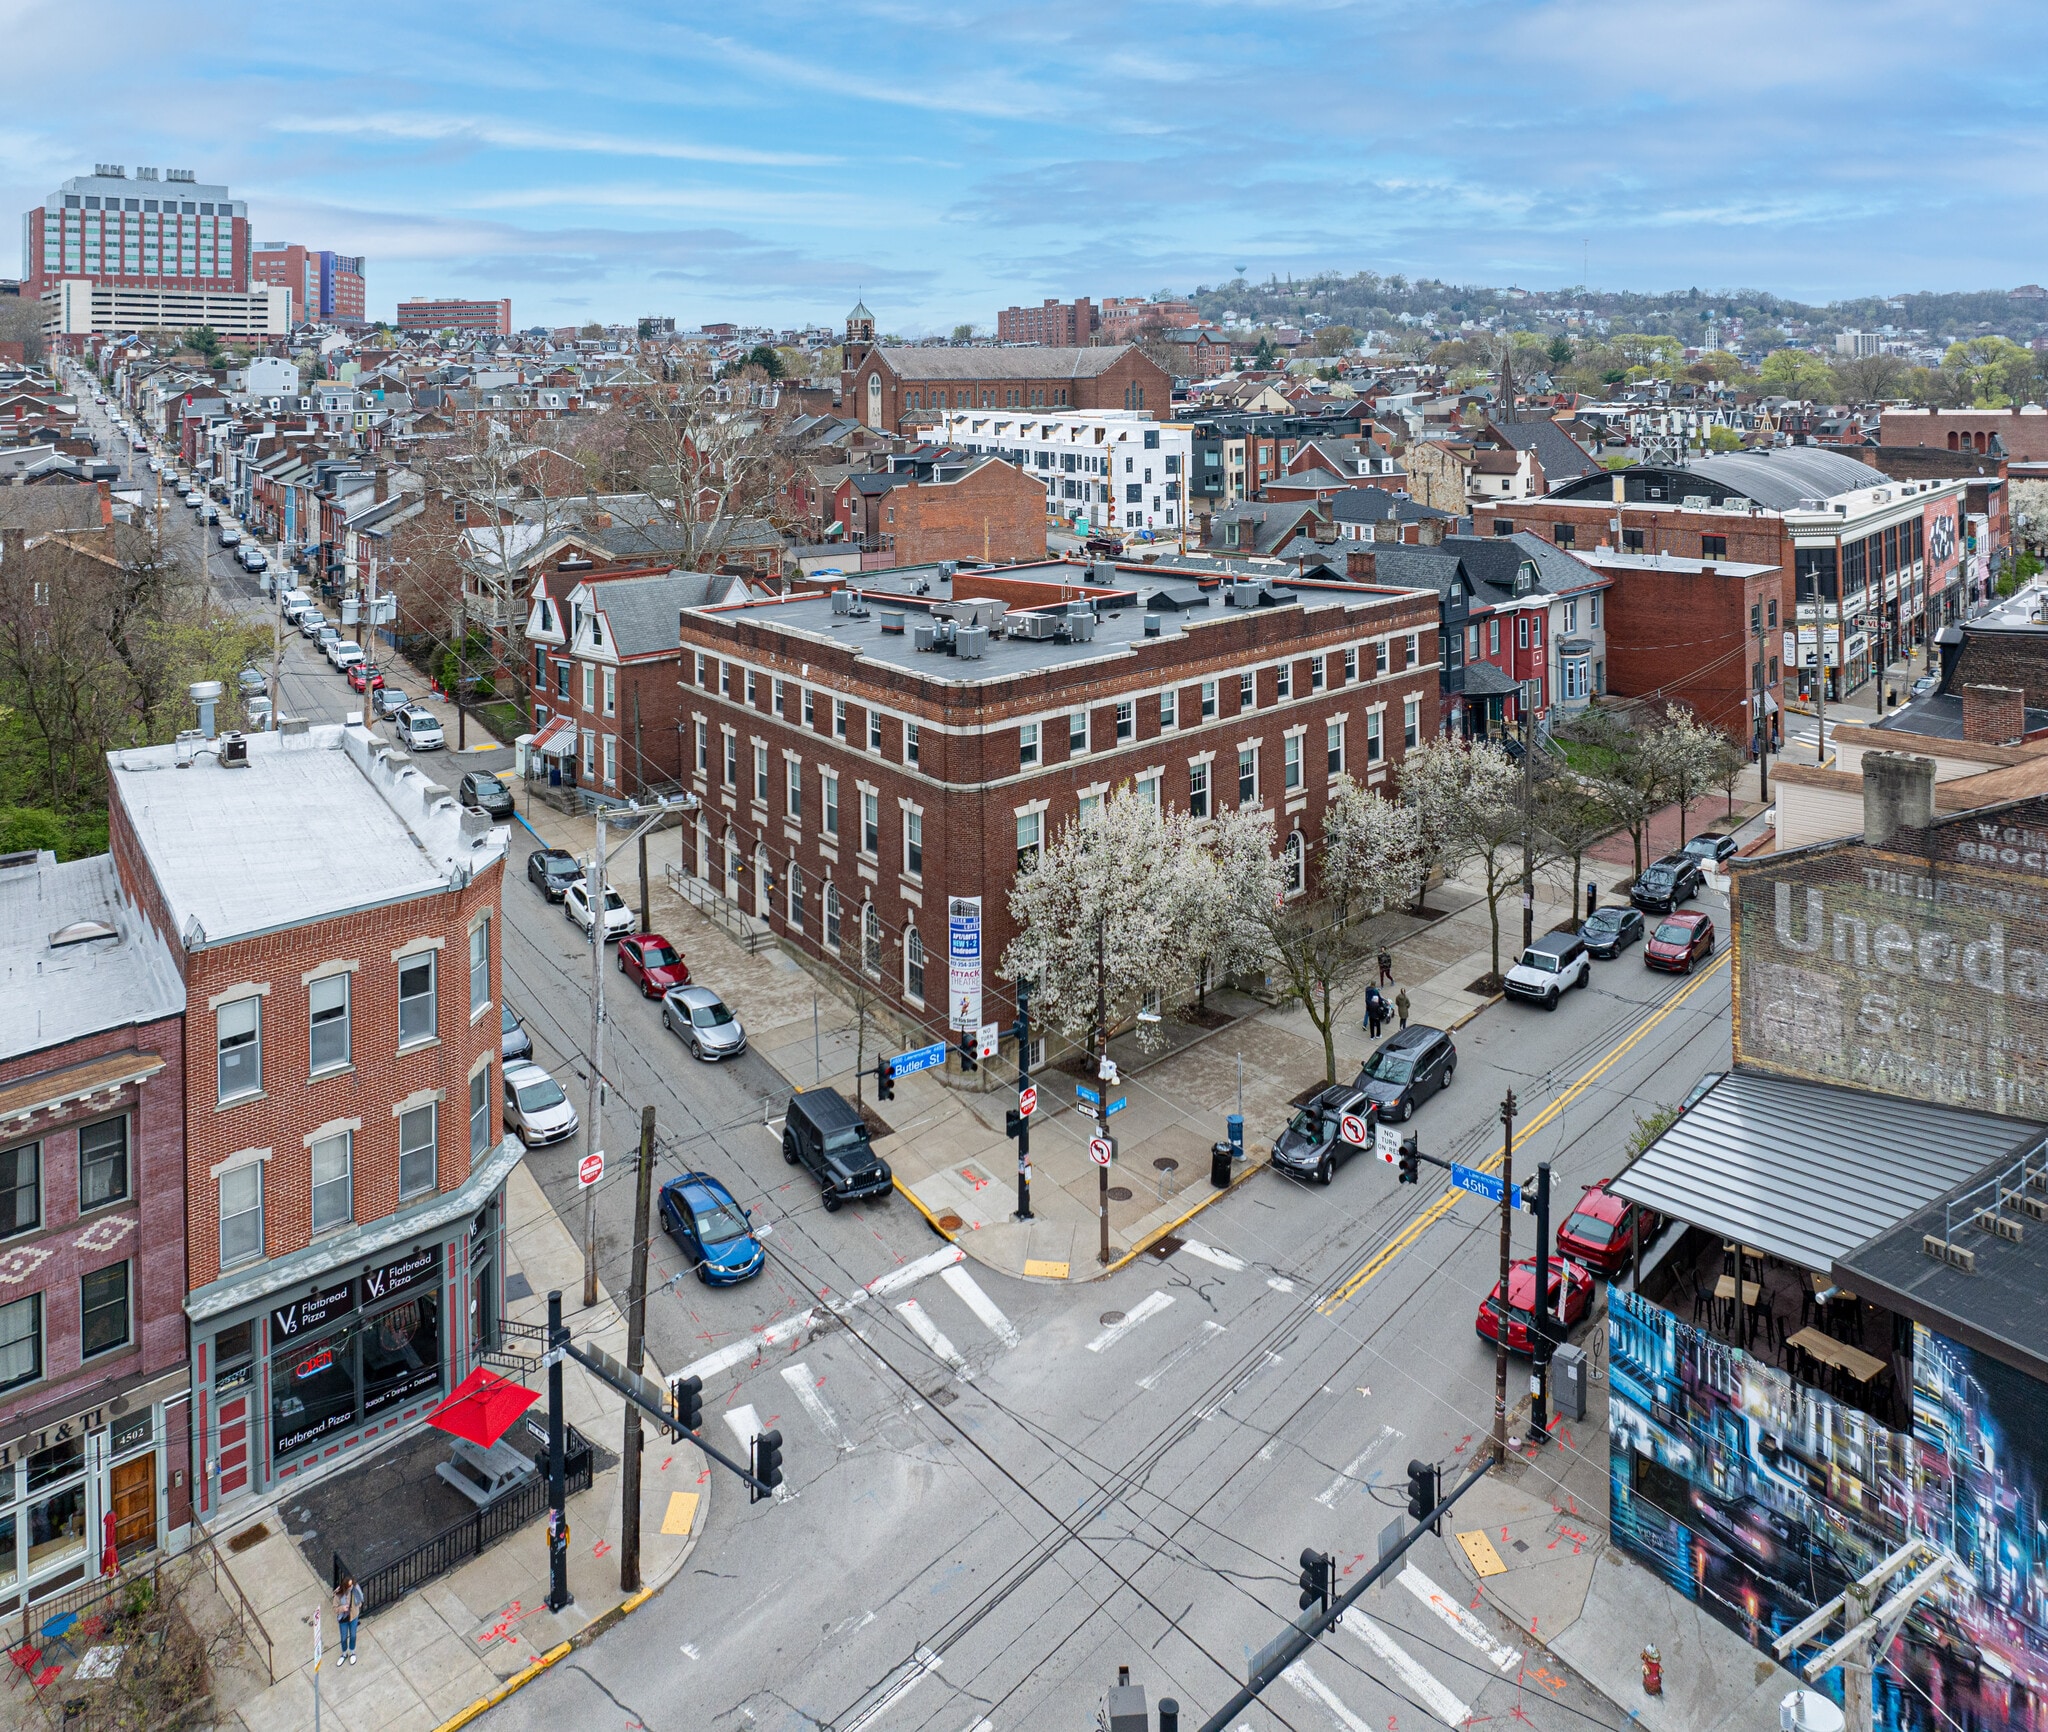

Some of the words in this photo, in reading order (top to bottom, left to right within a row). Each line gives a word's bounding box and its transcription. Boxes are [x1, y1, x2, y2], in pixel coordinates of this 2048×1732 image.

[953, 940, 965, 948] NEW
[951, 969, 980, 978] ATTACK
[895, 1060, 924, 1076] Butler
[929, 1053, 940, 1065] St
[1381, 1137, 1397, 1147] TURN
[1384, 1130, 1393, 1138] NO
[1378, 1143, 1386, 1151] ON
[1462, 1177, 1489, 1196] 45th
[389, 1253, 432, 1278] Flatbread
[389, 1275, 411, 1290] Pizza
[302, 1288, 348, 1314] Flatbread
[302, 1310, 326, 1326] Pizza
[296, 1350, 333, 1378] OPEN
[391, 1384, 408, 1398] Drinks
[413, 1372, 437, 1388] Desserts
[79, 1408, 103, 1432] TI
[119, 1427, 144, 1445] 4502
[279, 1422, 326, 1451] Flatbread
[327, 1411, 351, 1430] Pizza
